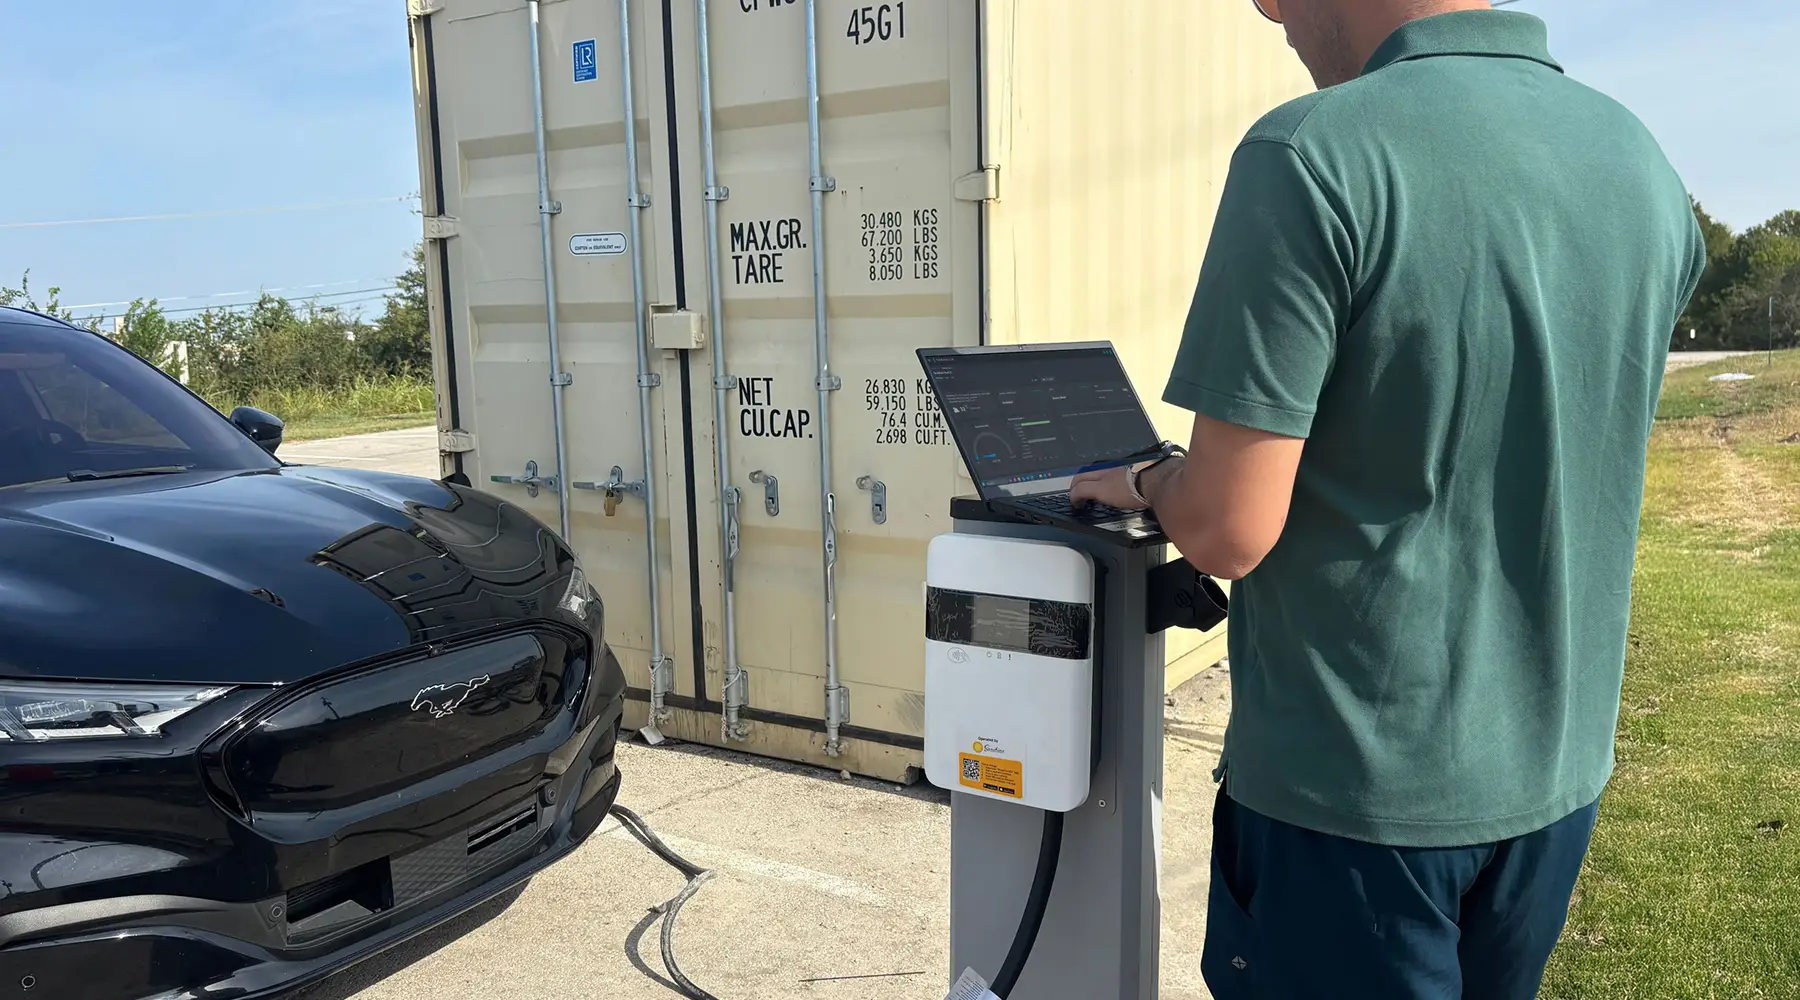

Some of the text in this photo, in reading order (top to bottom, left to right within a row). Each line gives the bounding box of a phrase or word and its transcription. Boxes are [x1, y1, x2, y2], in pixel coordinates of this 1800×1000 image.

[847, 2, 904, 45] 45G1
[914, 208, 938, 226] KGS
[730, 218, 807, 252] MAX.GR.
[914, 226, 938, 244] LBS
[914, 244, 938, 262] KGS
[732, 253, 784, 284] TARE
[914, 262, 938, 279] LBS
[738, 377, 774, 406] NET
[916, 378, 932, 394] KG
[740, 408, 813, 438] CU.CAP.
[881, 412, 944, 428] 76.4 CU.M.
[915, 428, 950, 446] CU.FT.
